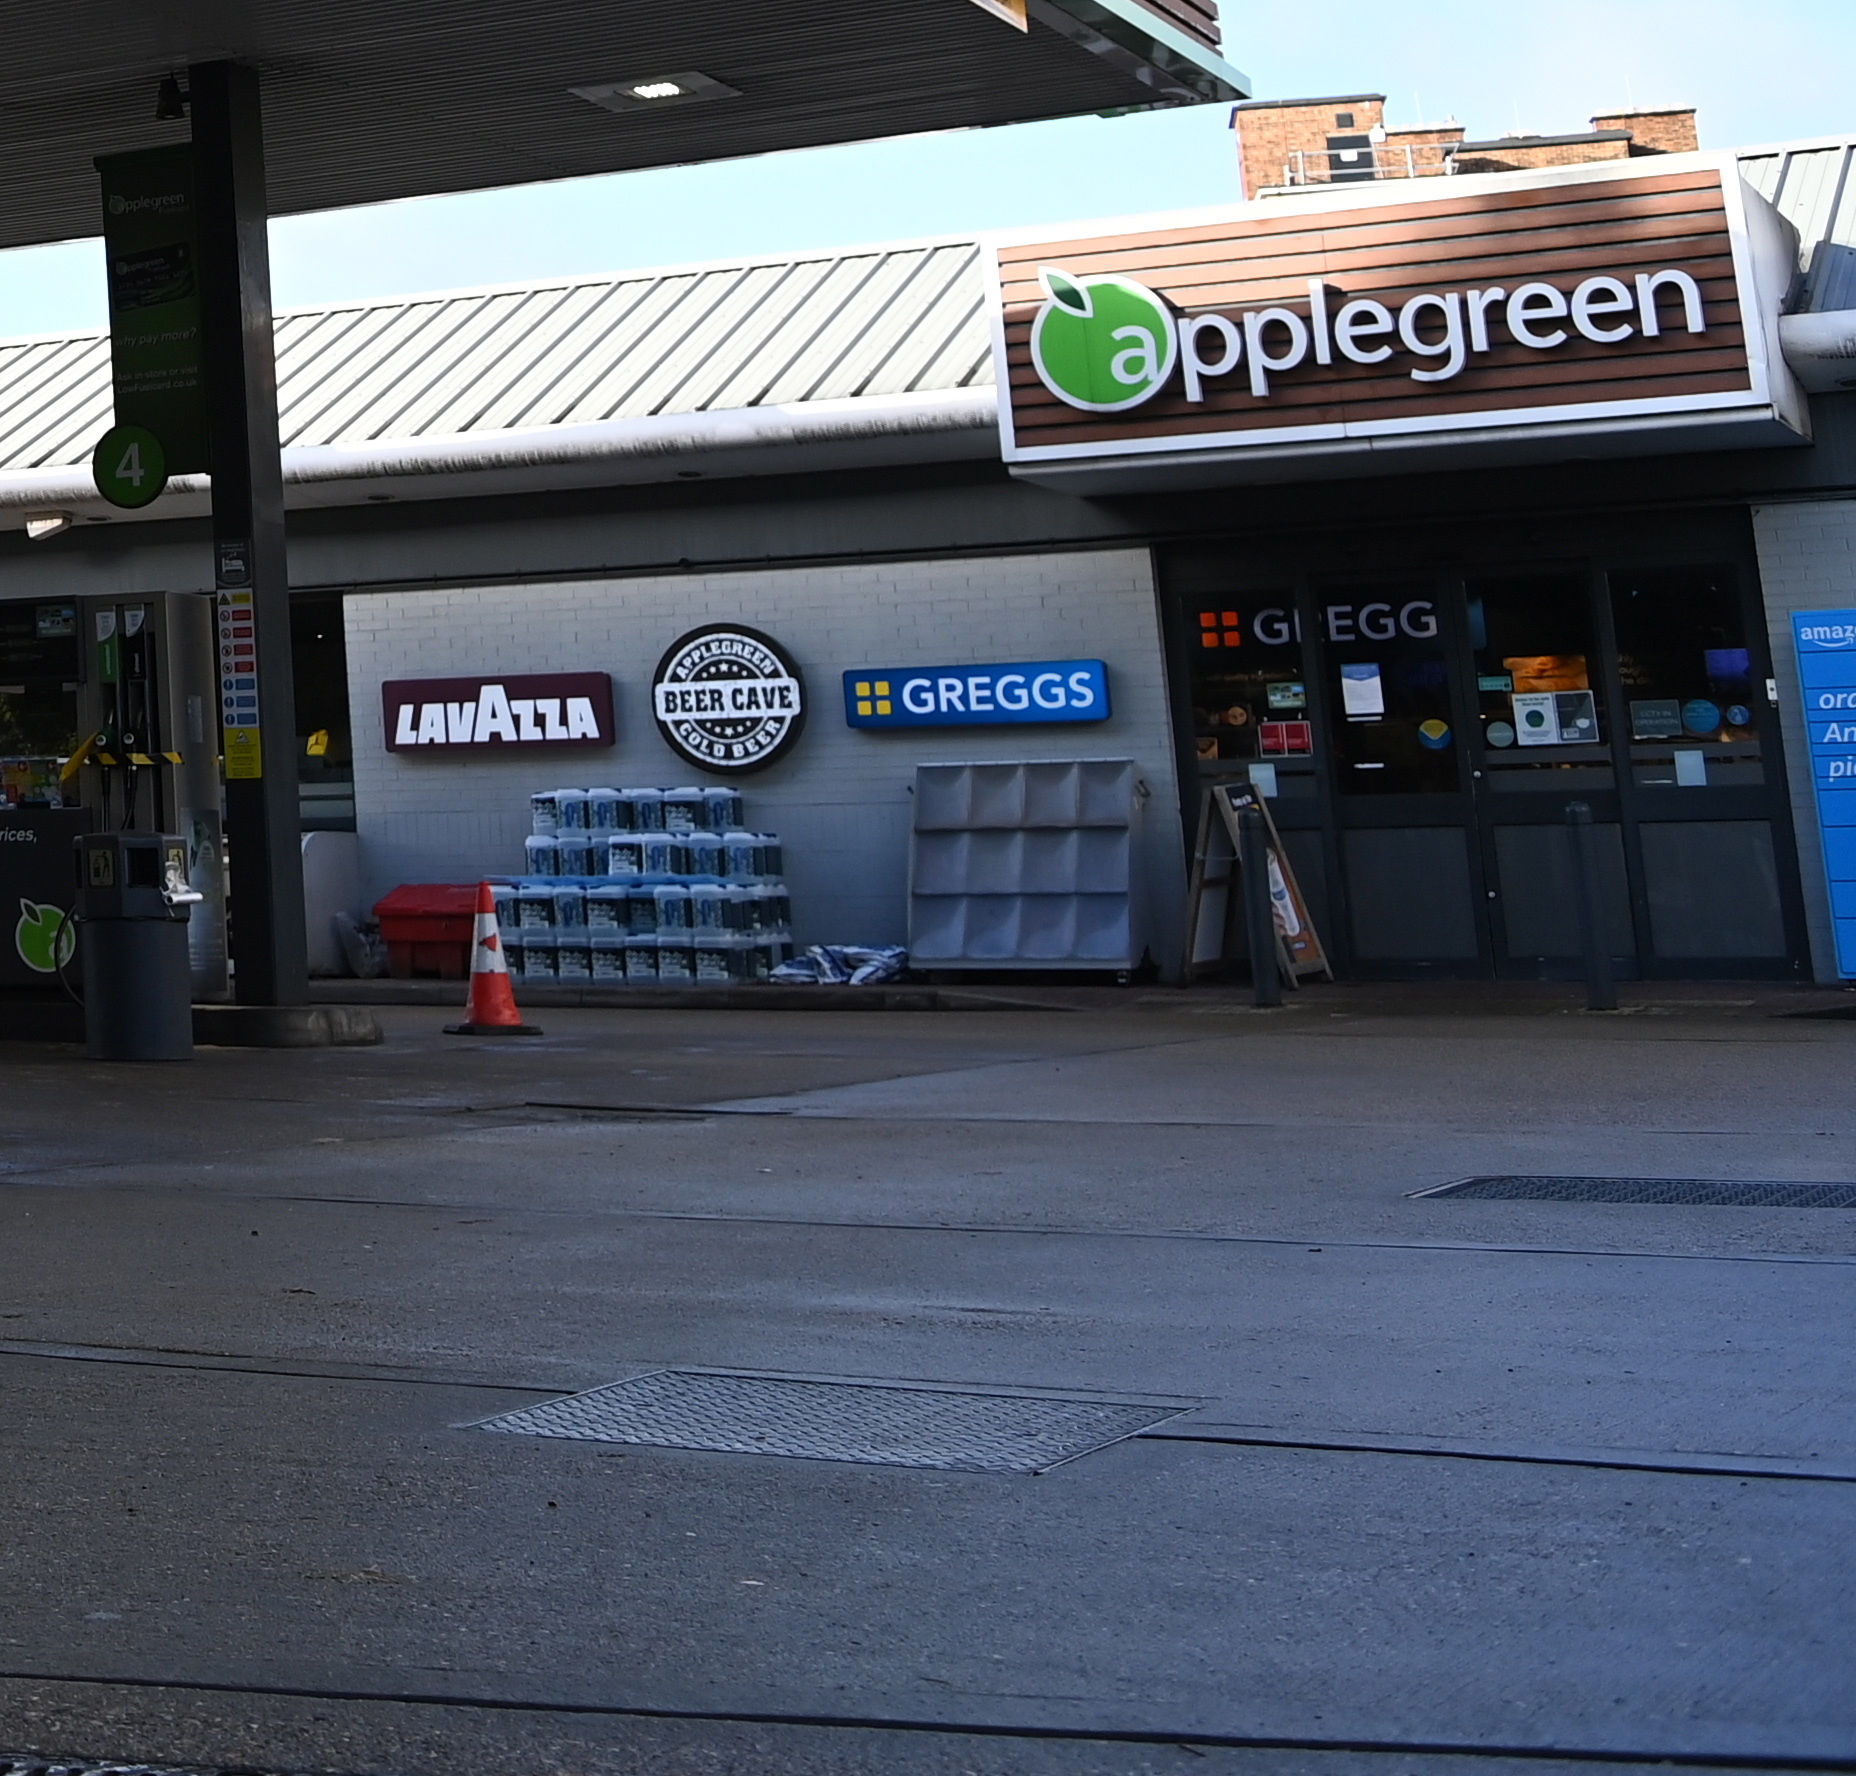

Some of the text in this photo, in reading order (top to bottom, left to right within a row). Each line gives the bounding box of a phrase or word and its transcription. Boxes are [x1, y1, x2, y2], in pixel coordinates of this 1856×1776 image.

[1110, 269, 1706, 403] applegreen
[116, 442, 144, 487] 4
[1800, 625, 1856, 641] amaz
[675, 640, 776, 679] APPLEGREEN
[663, 685, 793, 714] BEER CAVE
[902, 670, 1095, 715] GREGGS
[394, 683, 600, 745] LAVAZZA
[679, 719, 782, 758] COLD BEER
